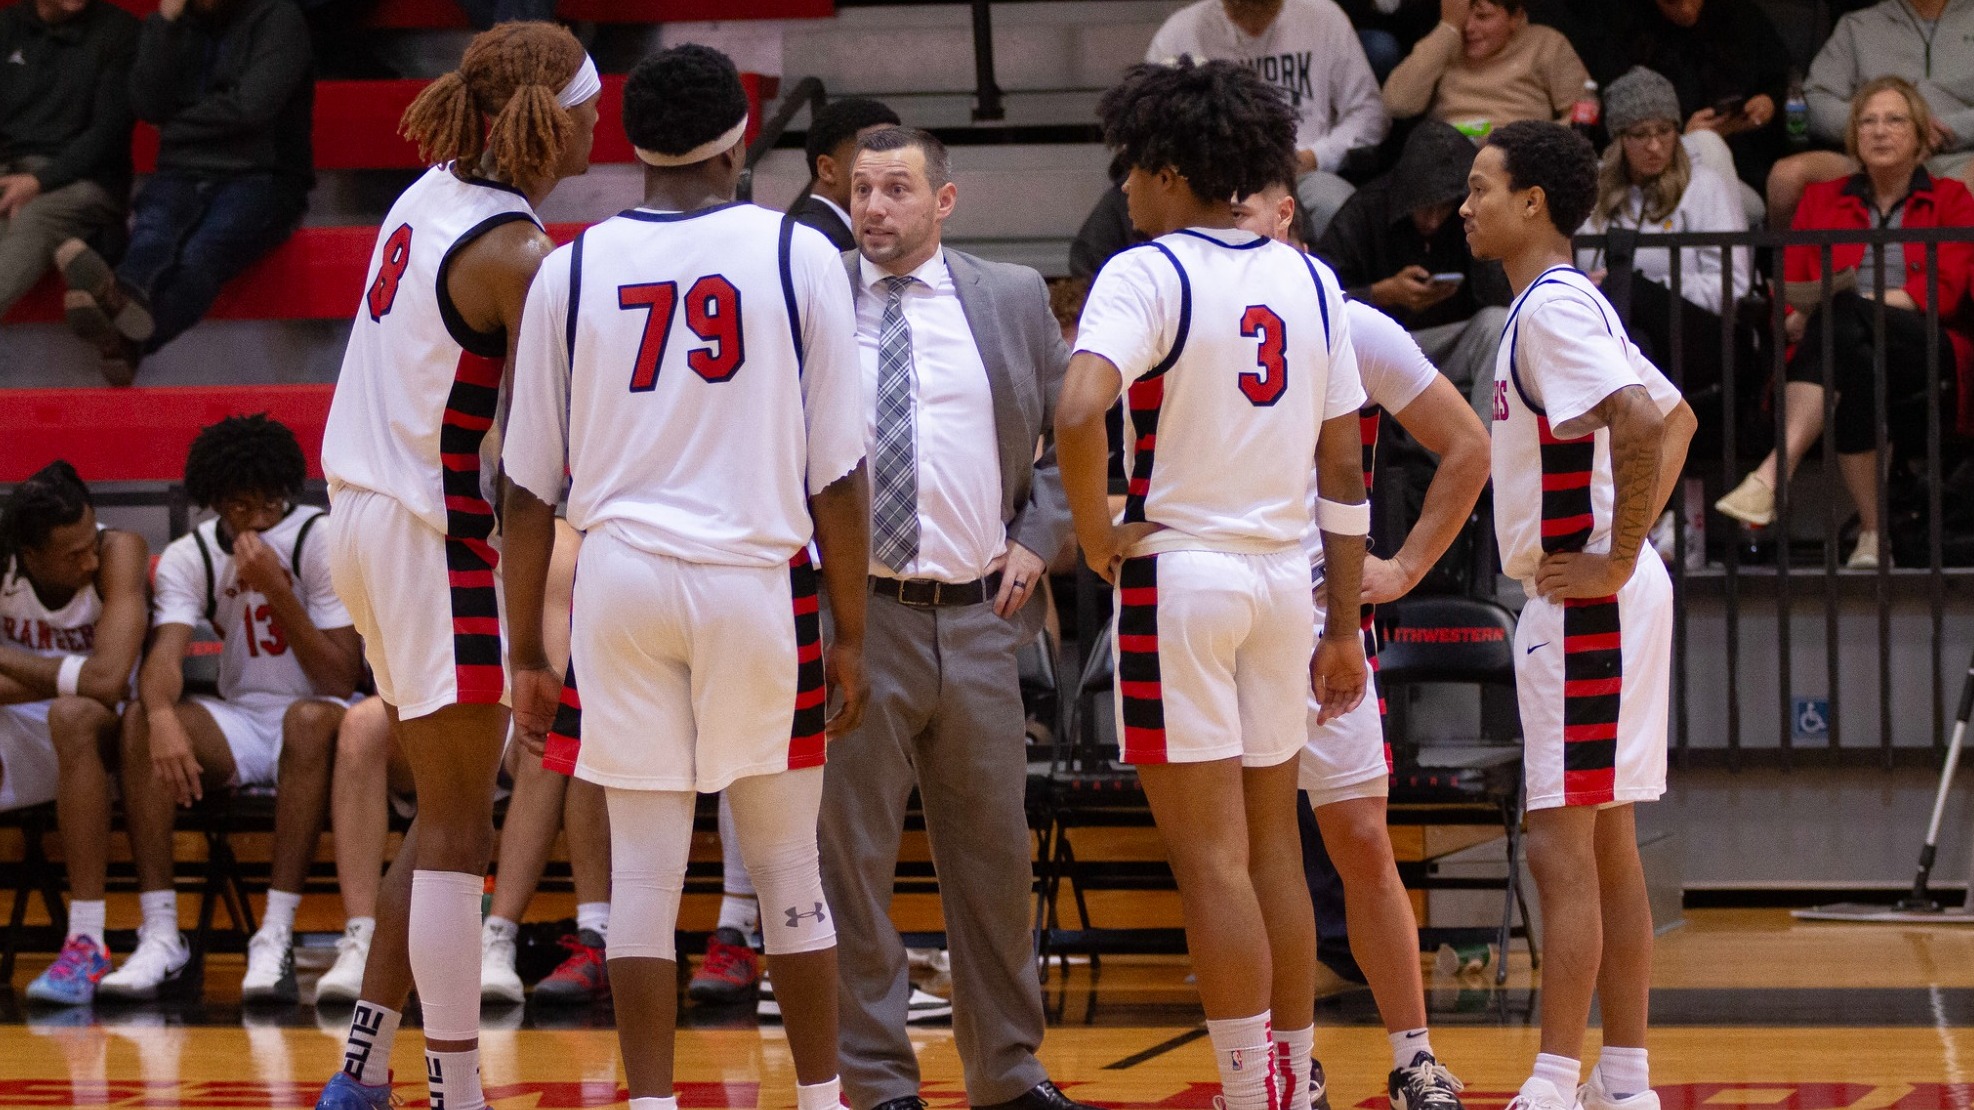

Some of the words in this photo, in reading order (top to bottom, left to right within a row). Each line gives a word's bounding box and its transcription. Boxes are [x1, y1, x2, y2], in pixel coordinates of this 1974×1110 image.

[367, 222, 414, 324] 8
[617, 273, 746, 393] 79
[1238, 304, 1288, 407] 3
[3, 616, 95, 651] RANGER
[244, 603, 289, 658] 13
[1383, 626, 1505, 643] THWESTERN
